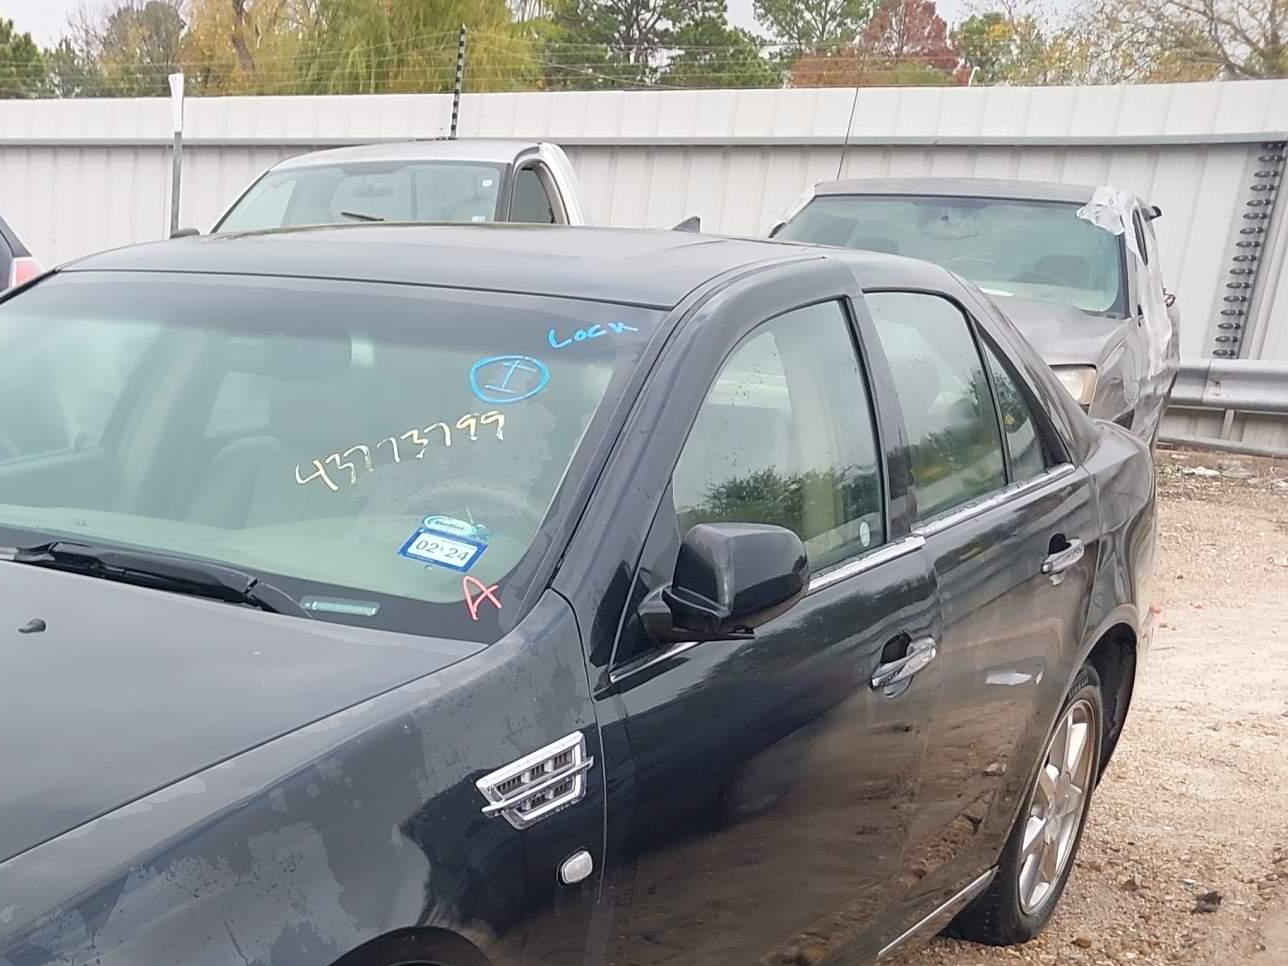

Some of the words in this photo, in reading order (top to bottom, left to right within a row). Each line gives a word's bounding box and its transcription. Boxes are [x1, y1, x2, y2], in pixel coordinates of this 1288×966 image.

[294, 410, 505, 492] 43773799
[444, 547, 470, 562] 24
[462, 575, 503, 621] A
